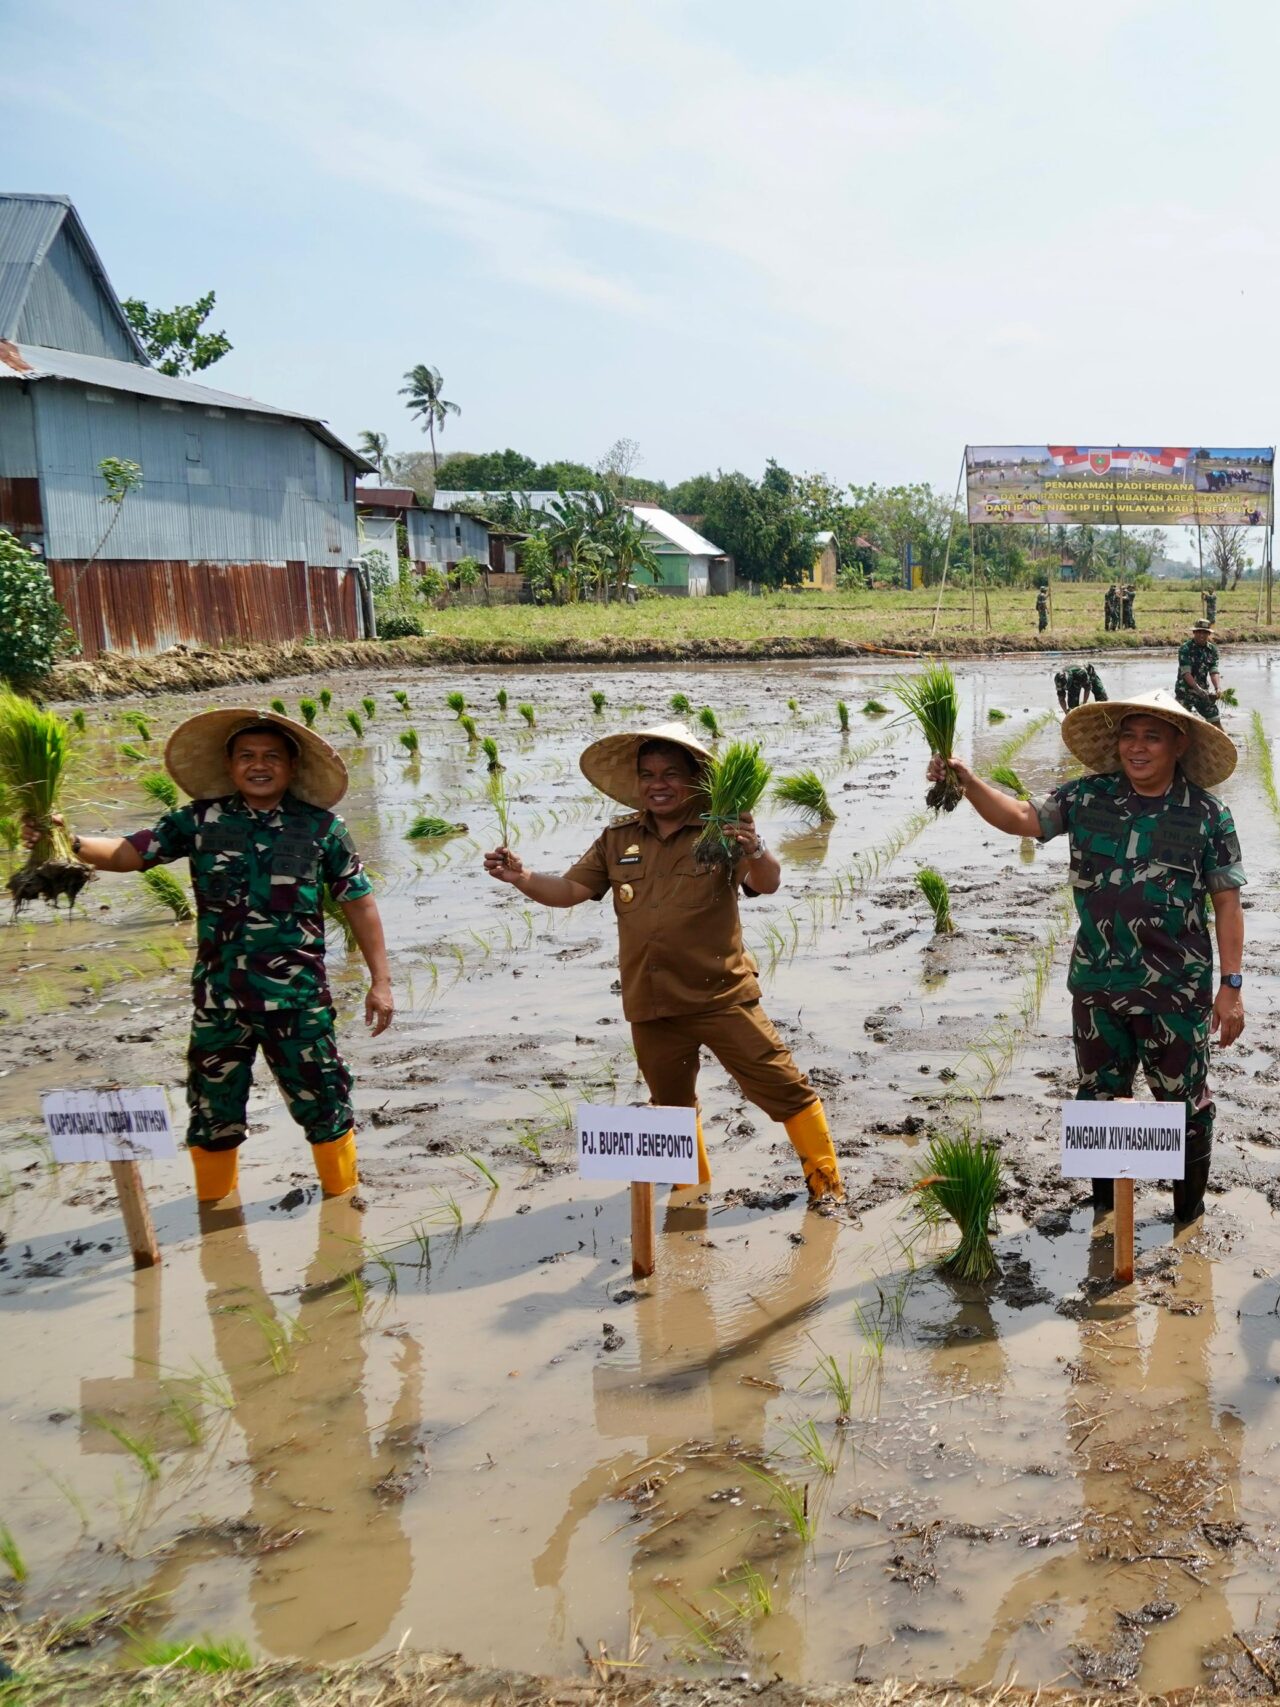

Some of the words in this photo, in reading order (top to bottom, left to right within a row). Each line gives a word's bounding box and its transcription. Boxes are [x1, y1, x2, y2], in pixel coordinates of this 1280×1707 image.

[1045, 481, 1113, 489] PENANAMAN
[1116, 482, 1141, 490] PADI
[1166, 494, 1196, 502] AREAL
[985, 504, 1011, 512] DARI
[1080, 504, 1090, 512] IP
[1116, 505, 1165, 513] WILAYAH
[1195, 505, 1255, 514] JENEPONTO
[1066, 1126, 1107, 1149] PANGDAM
[1108, 1126, 1181, 1152] XIV/HASANUDDIN
[582, 1131, 597, 1155] PJ.
[599, 1132, 634, 1156] BUPATI
[636, 1133, 693, 1159] JENEPONTO
